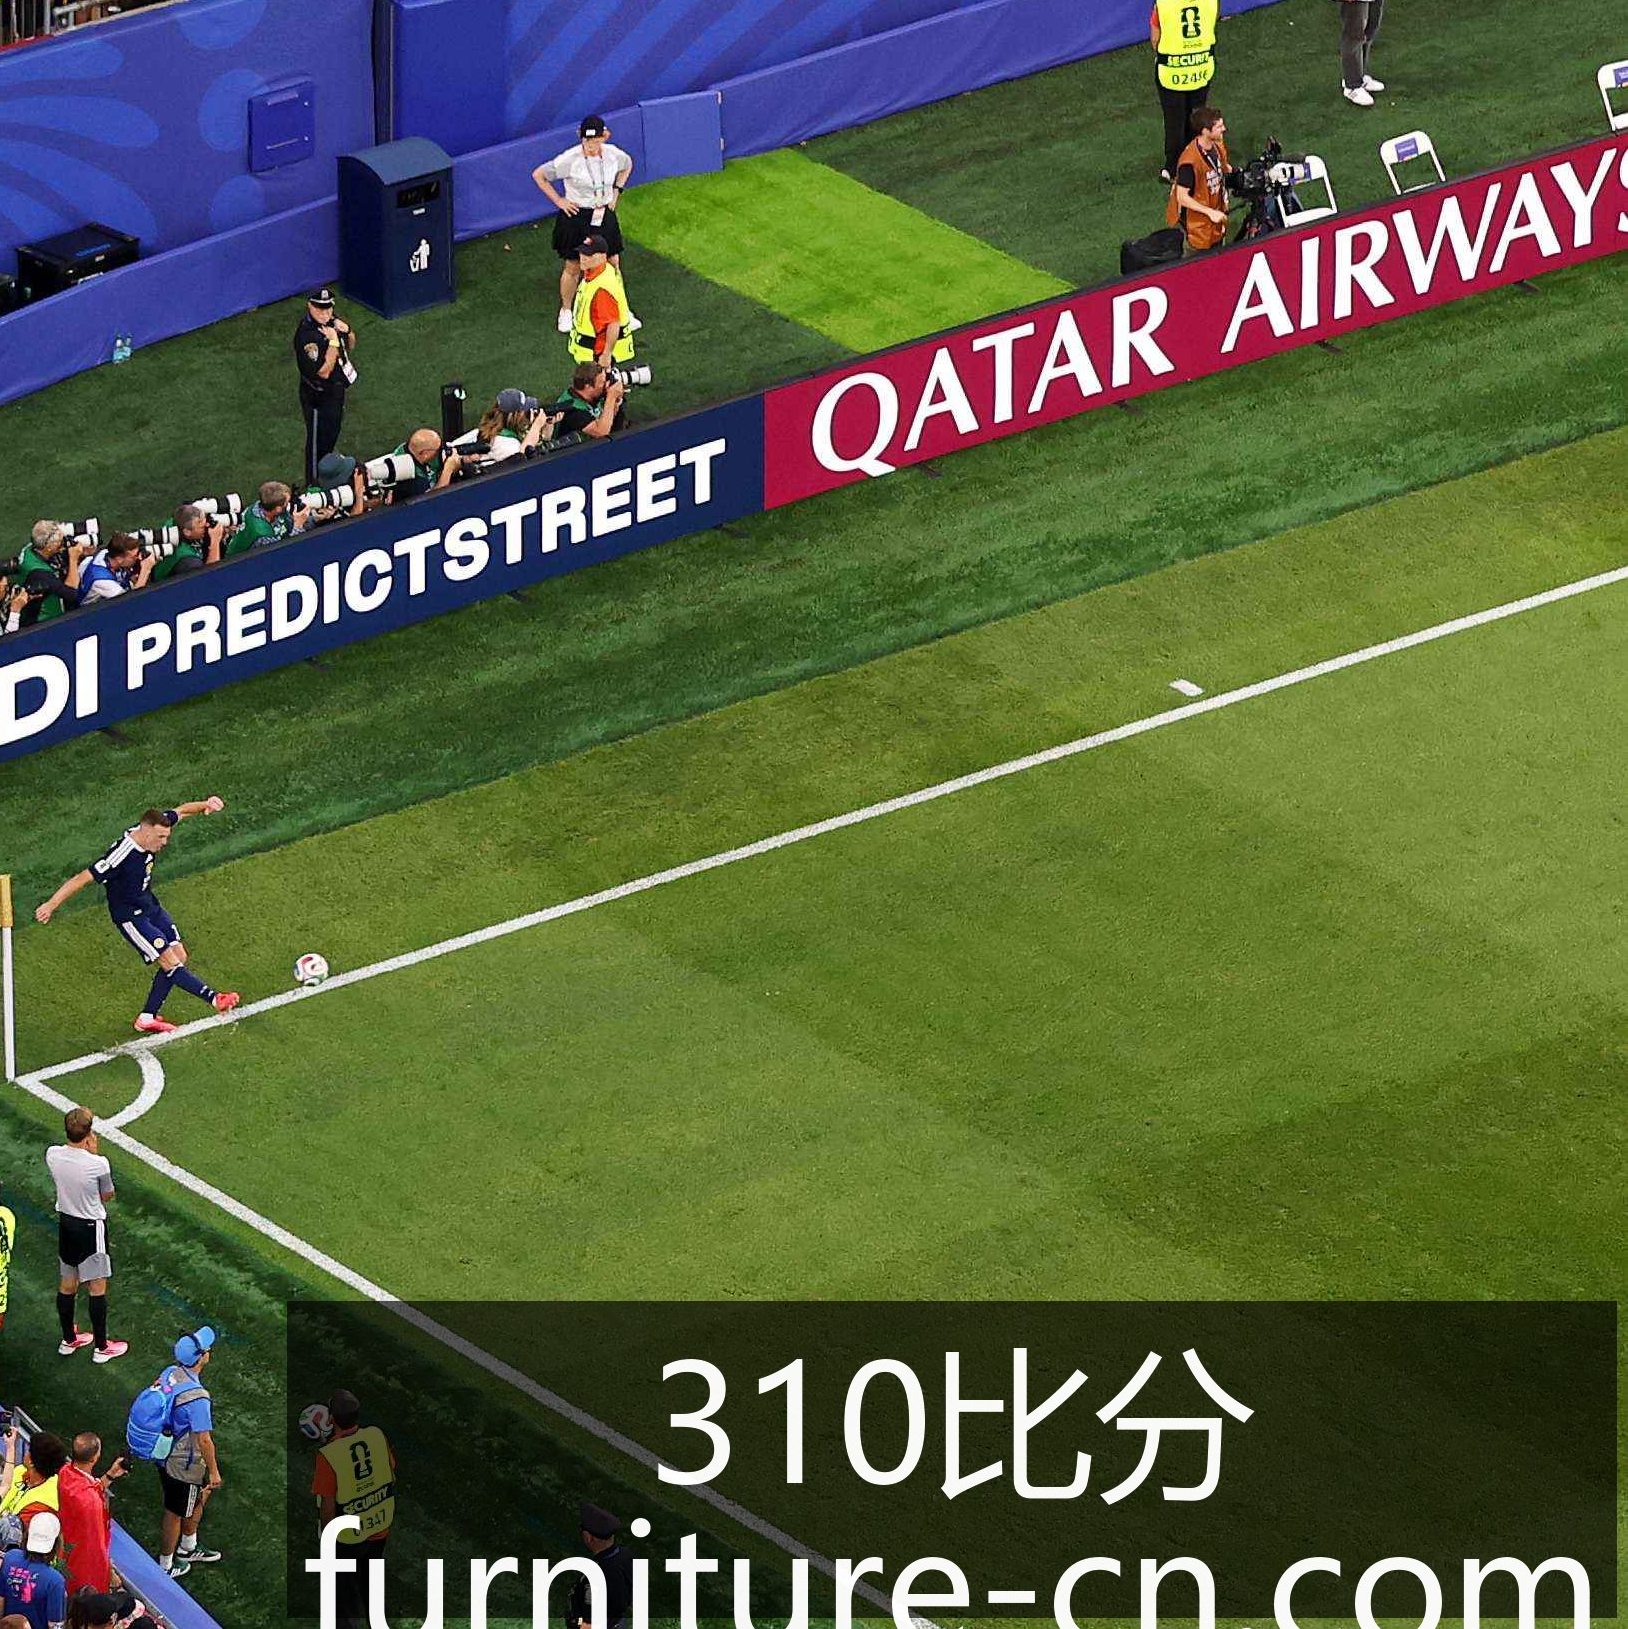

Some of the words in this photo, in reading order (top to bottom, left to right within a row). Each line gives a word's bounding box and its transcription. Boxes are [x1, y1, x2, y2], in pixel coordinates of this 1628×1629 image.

[810, 284, 1176, 478] QATAR
[1220, 148, 1628, 353] AIRWAY
[126, 437, 728, 691] PREDICTSTREET
